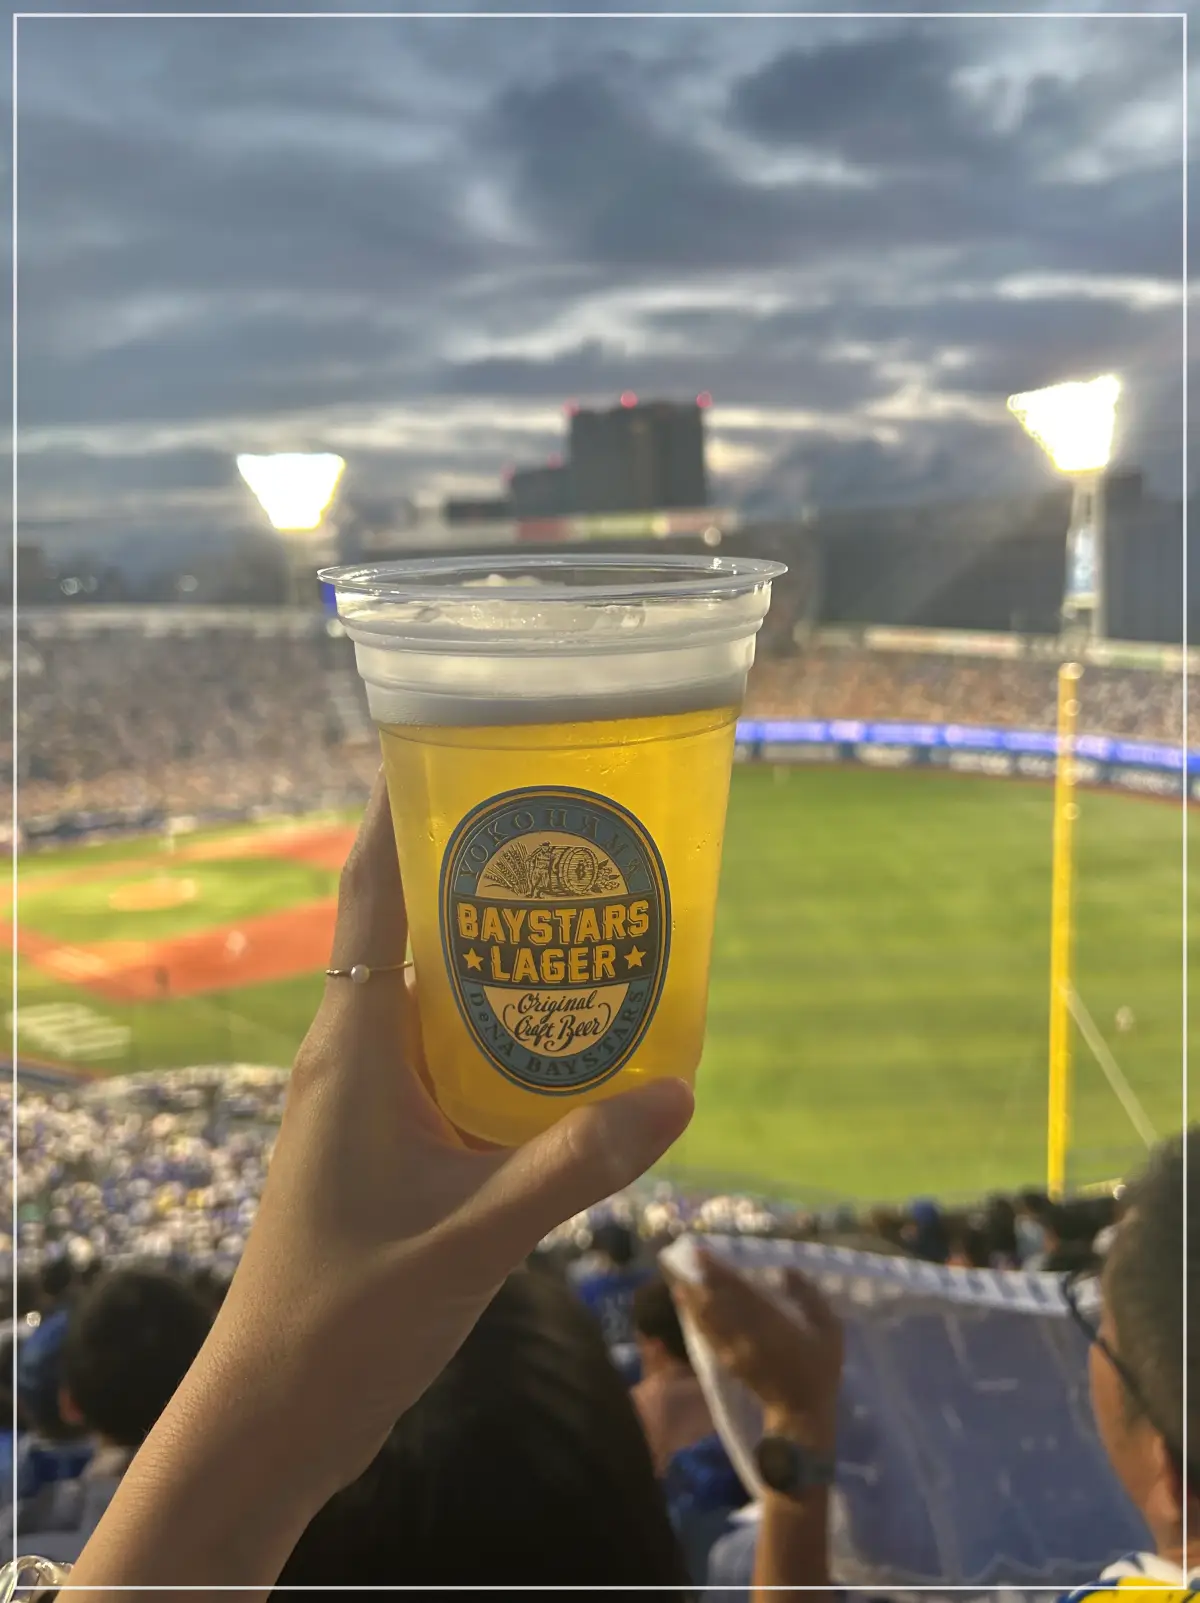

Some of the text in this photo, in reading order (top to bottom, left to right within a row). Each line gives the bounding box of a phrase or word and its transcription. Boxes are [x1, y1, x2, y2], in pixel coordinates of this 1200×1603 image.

[456, 899, 649, 944] BAYSTARS
[490, 945, 617, 983] LAGER
[517, 990, 597, 1024] Original
[469, 990, 645, 1076] DeNA BAYSTARS
[514, 1014, 604, 1051] Craft Beer
